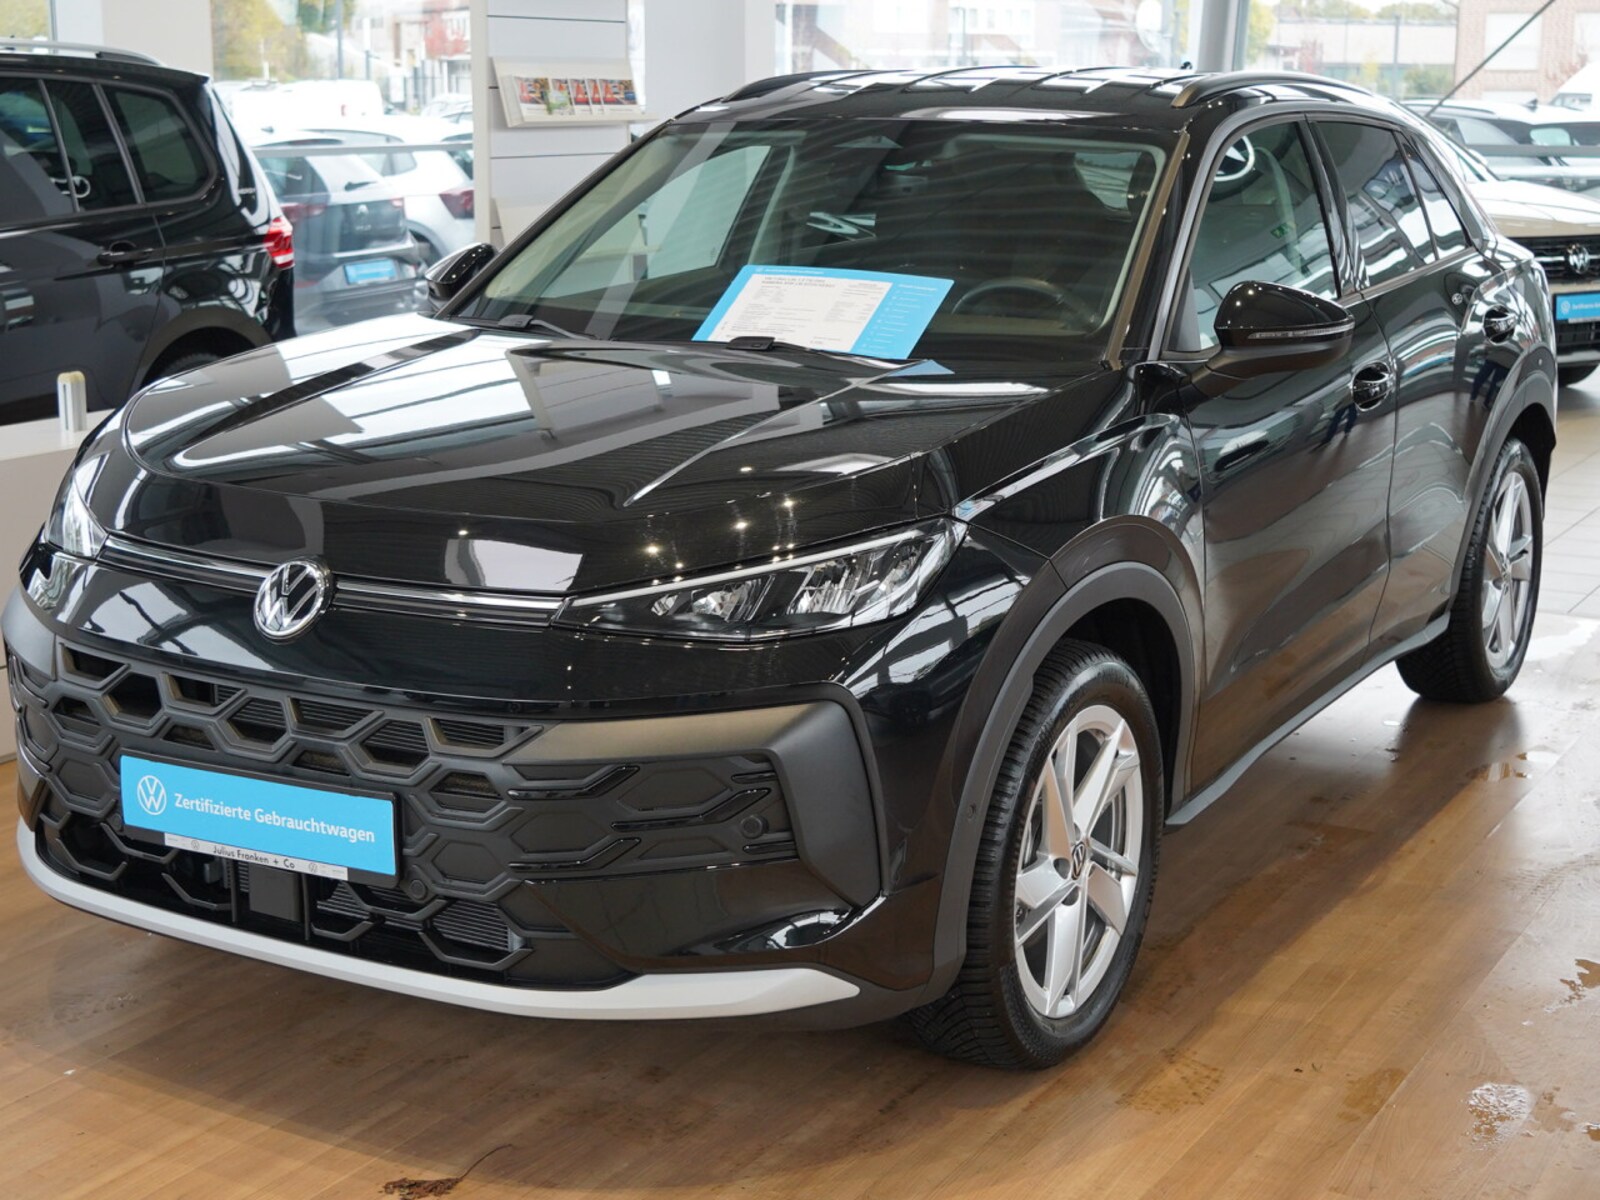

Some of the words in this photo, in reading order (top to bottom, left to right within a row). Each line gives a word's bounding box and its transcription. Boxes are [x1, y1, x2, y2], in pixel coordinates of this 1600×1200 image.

[138, 775, 167, 815] VW
[175, 793, 251, 821] Zertifizierte
[255, 808, 375, 843] Gebrauchtwagen
[213, 845, 235, 857] Julius
[237, 849, 269, 864] Franken
[283, 858, 295, 869] Co
